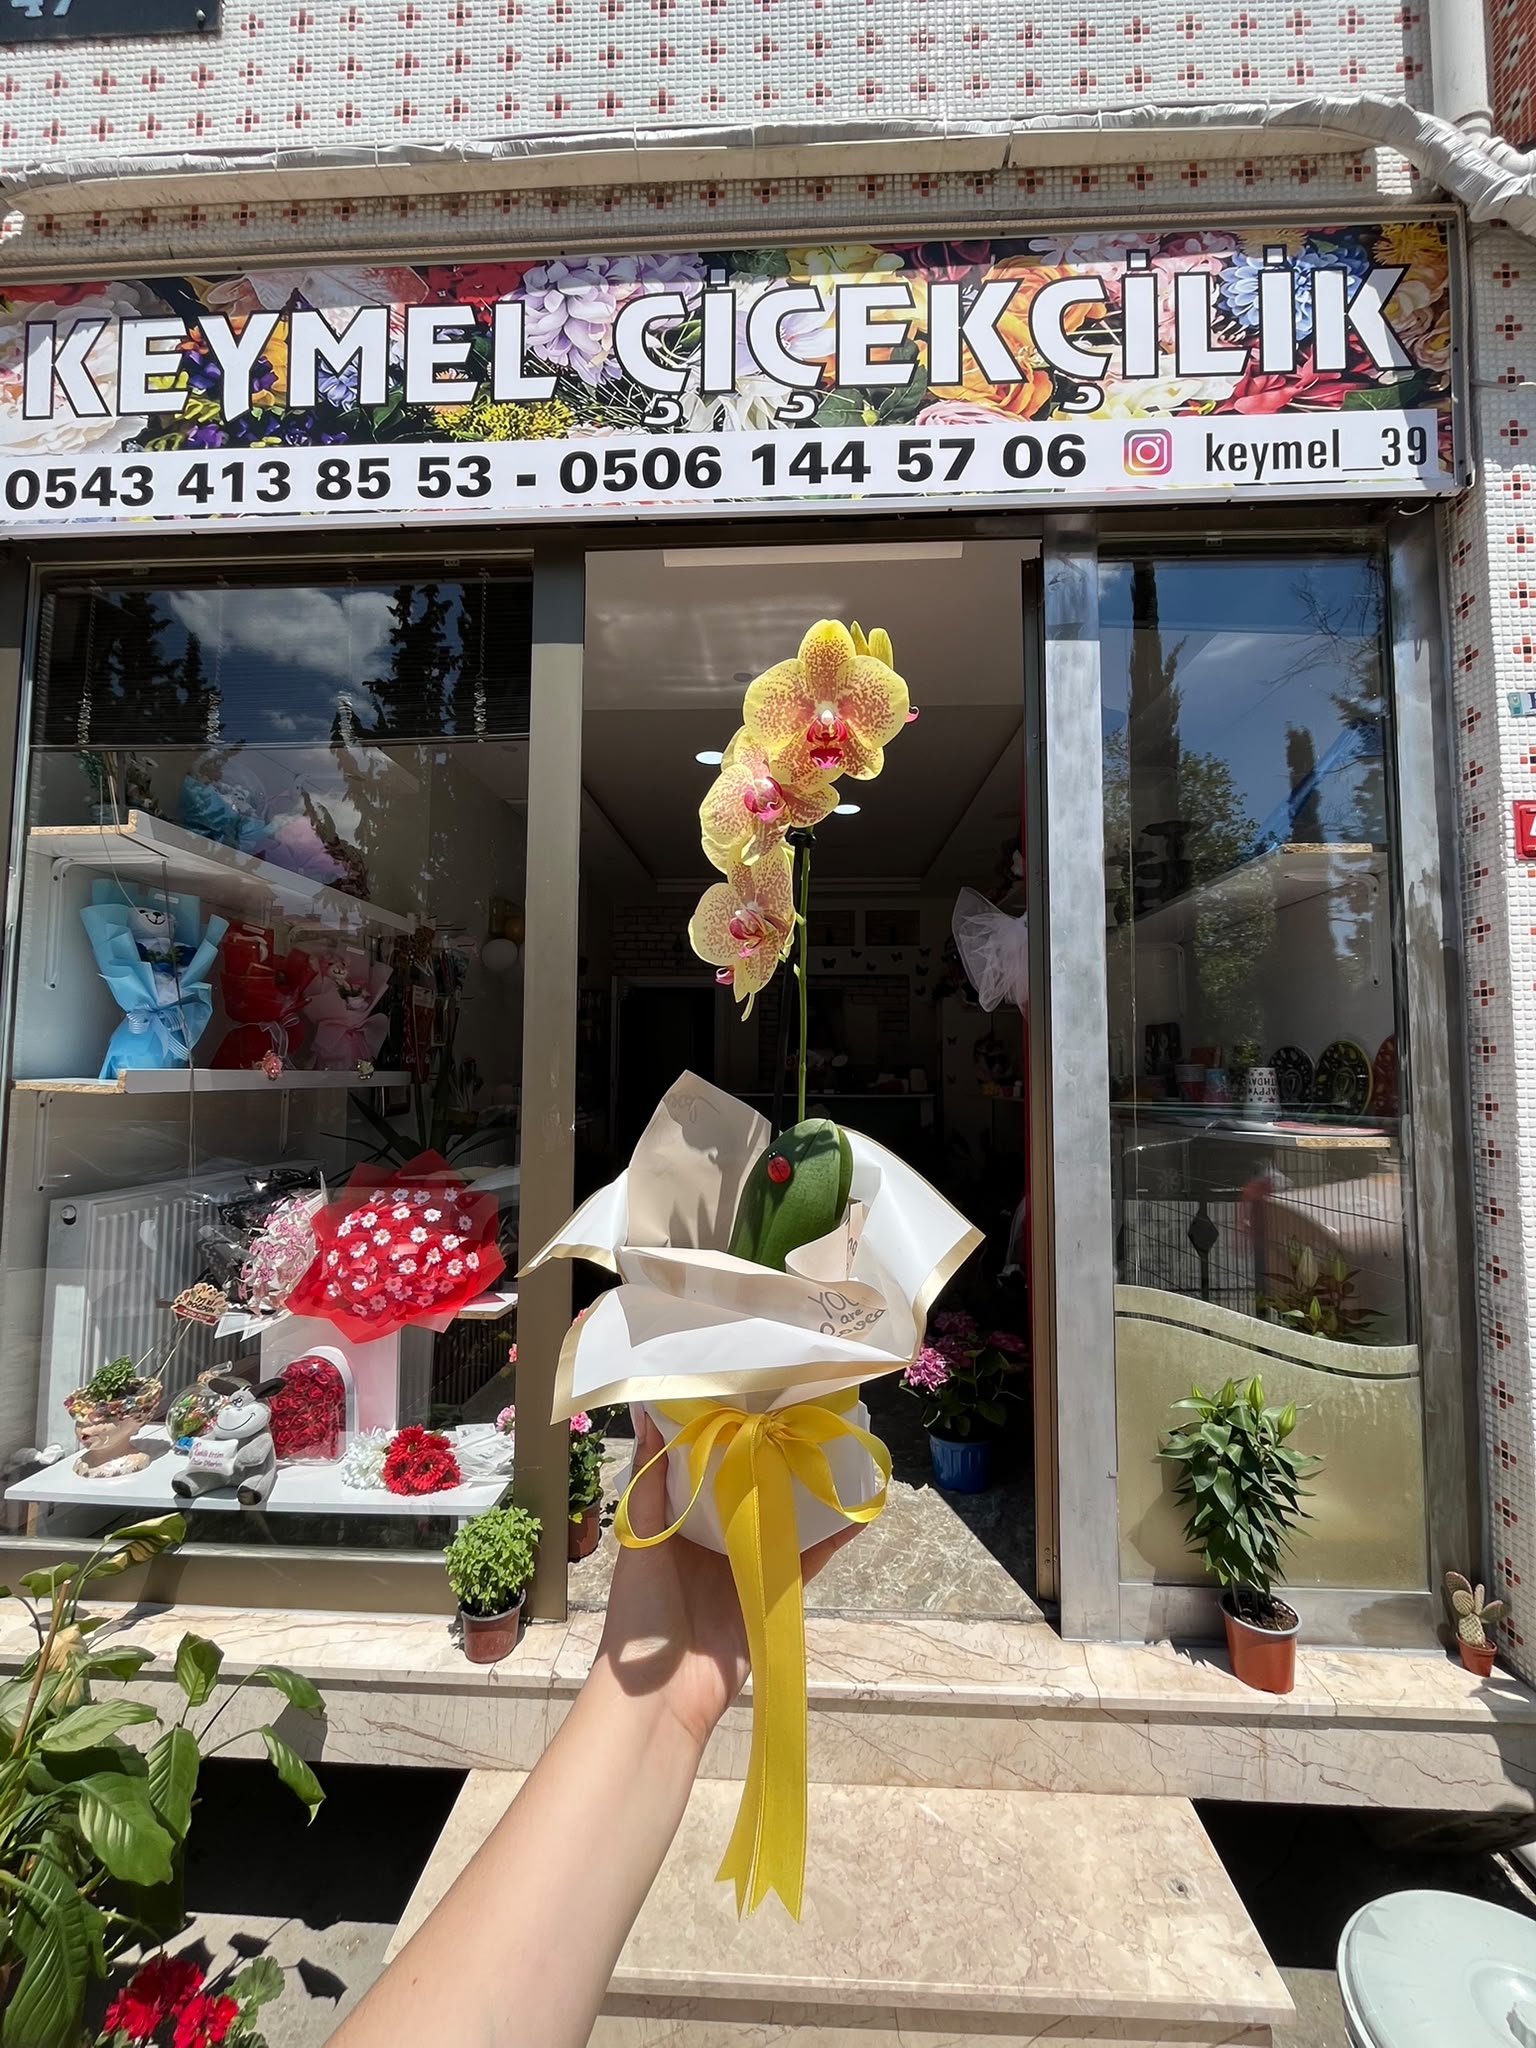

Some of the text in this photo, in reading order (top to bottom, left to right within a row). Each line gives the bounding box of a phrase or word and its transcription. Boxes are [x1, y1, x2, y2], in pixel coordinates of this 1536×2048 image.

[23, 244, 1416, 427] KEYMEL ÇİÇEKÇİLİK
[5, 434, 1087, 511] 0543 413 85 53 - 0506 144 57 06
[840, 1308, 863, 1324] are
